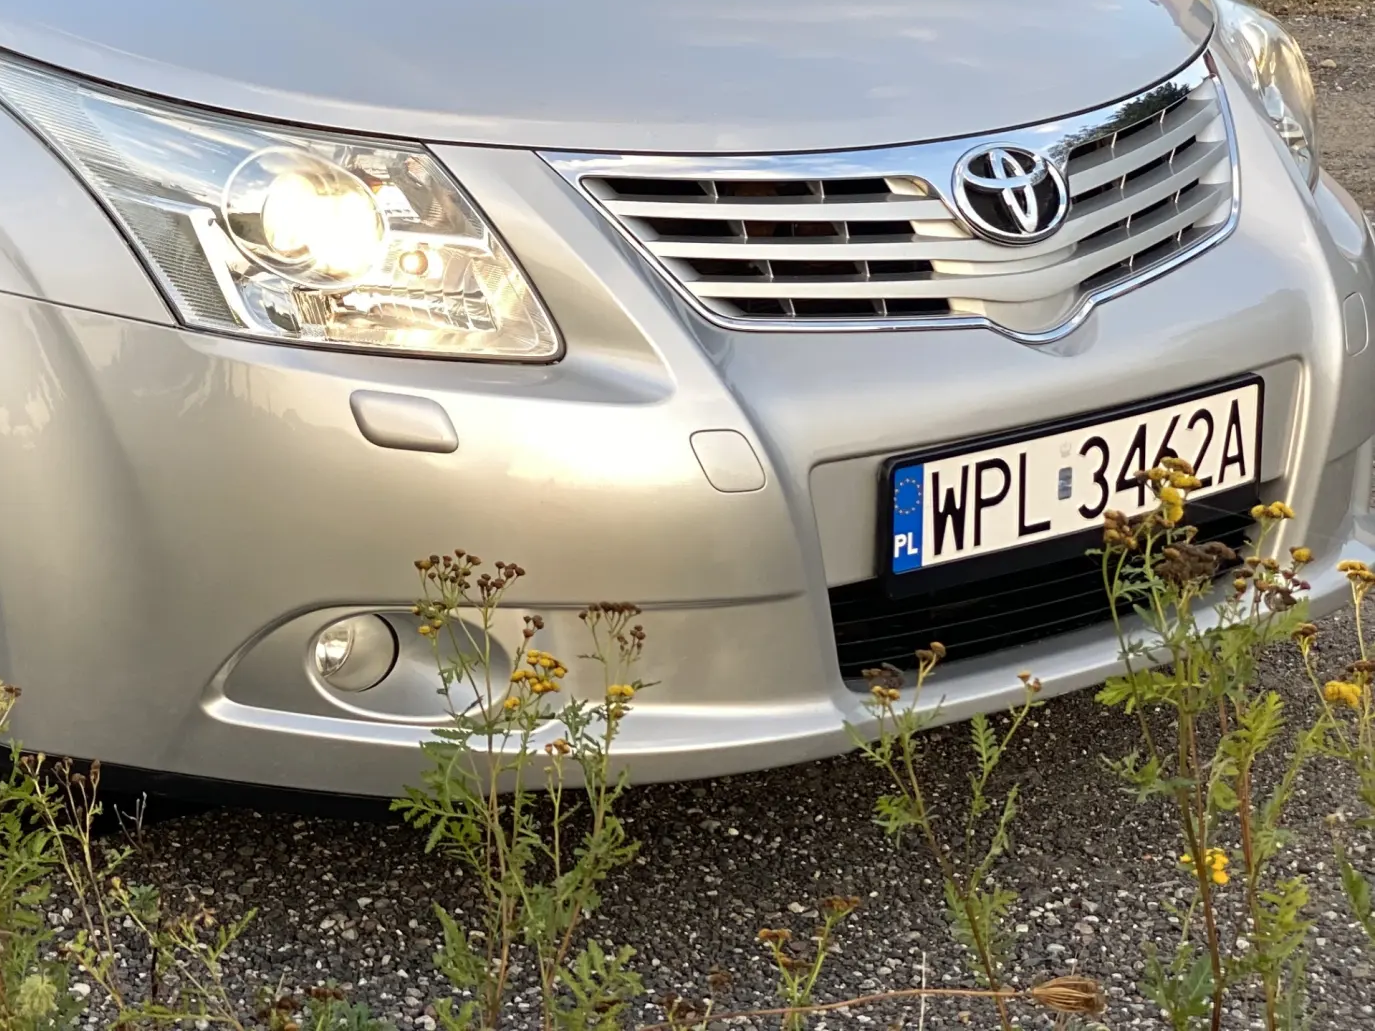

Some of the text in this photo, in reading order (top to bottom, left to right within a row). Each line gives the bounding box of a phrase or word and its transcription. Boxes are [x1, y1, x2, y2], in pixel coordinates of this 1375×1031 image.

[931, 399, 1246, 556] WPL 3462A
[894, 532, 918, 558] PL
